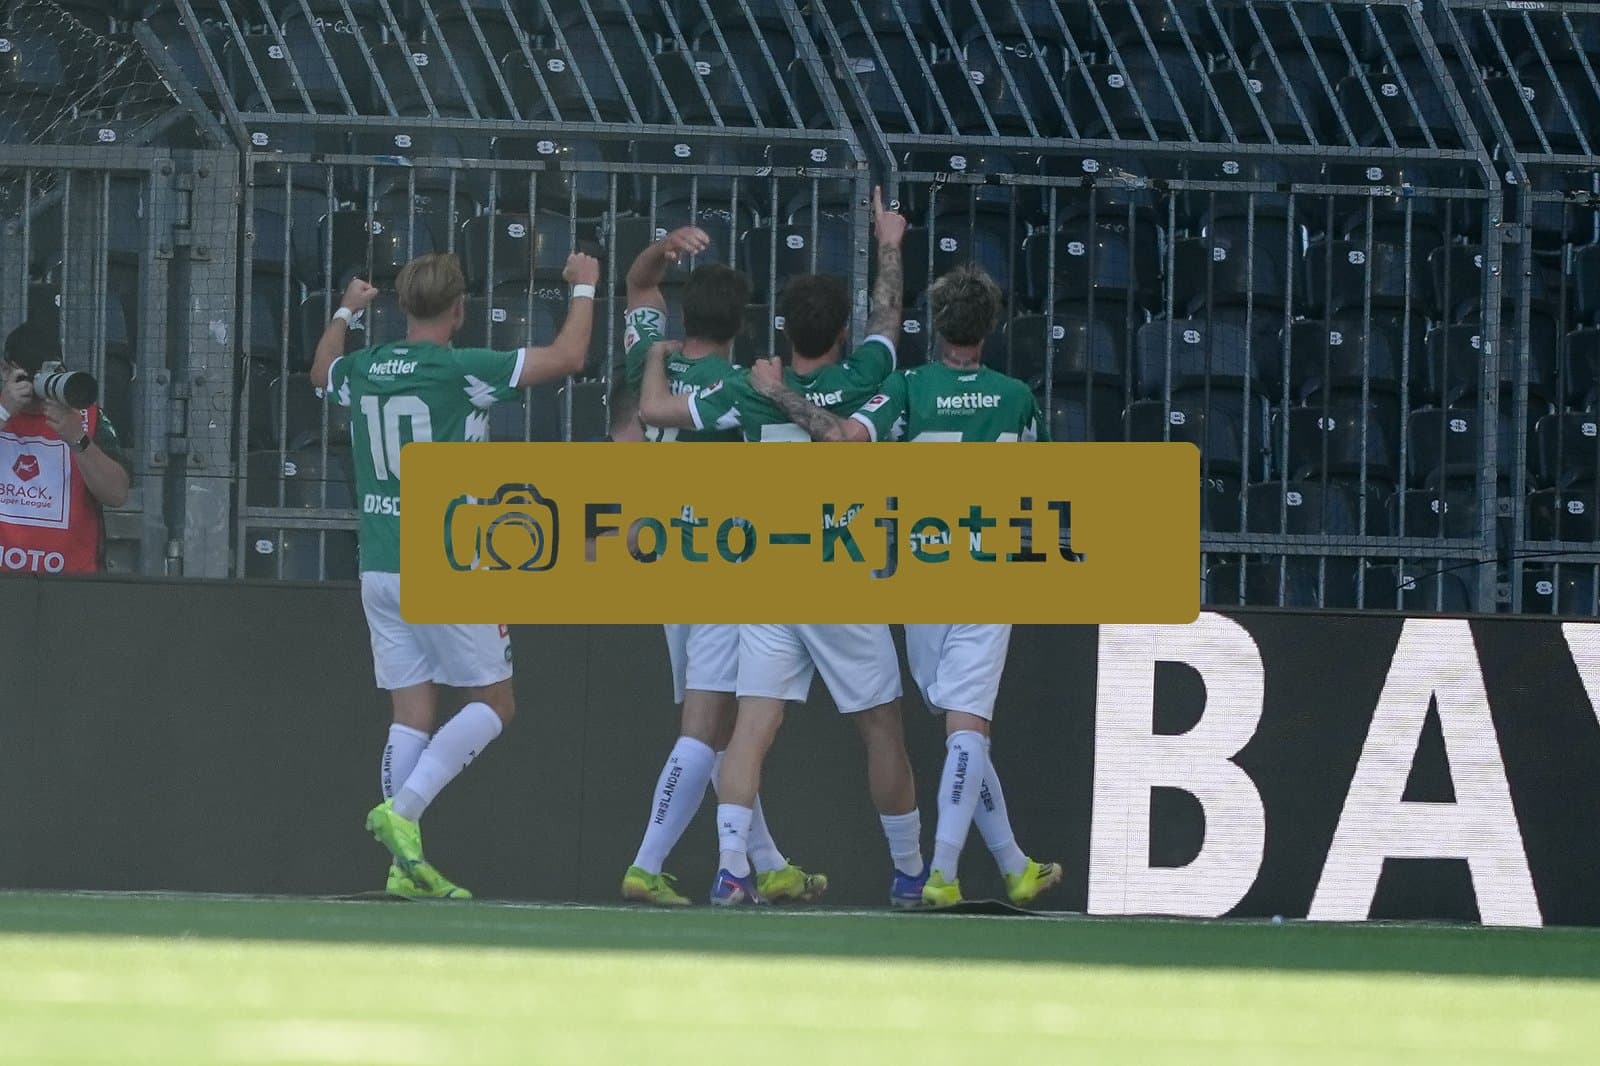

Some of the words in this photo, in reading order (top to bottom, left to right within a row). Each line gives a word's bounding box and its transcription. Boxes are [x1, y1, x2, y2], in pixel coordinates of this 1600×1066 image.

[368, 359, 418, 375] Mettler
[667, 379, 701, 397] tler
[805, 389, 843, 407] tler
[936, 392, 1001, 409] Mettler
[359, 395, 433, 480] 10
[0, 497, 19, 505] uper
[20, 498, 52, 509] League
[0, 546, 65, 573] OTO
[1087, 611, 1600, 929] BA
[654, 766, 683, 825] HIRSLANDEN
